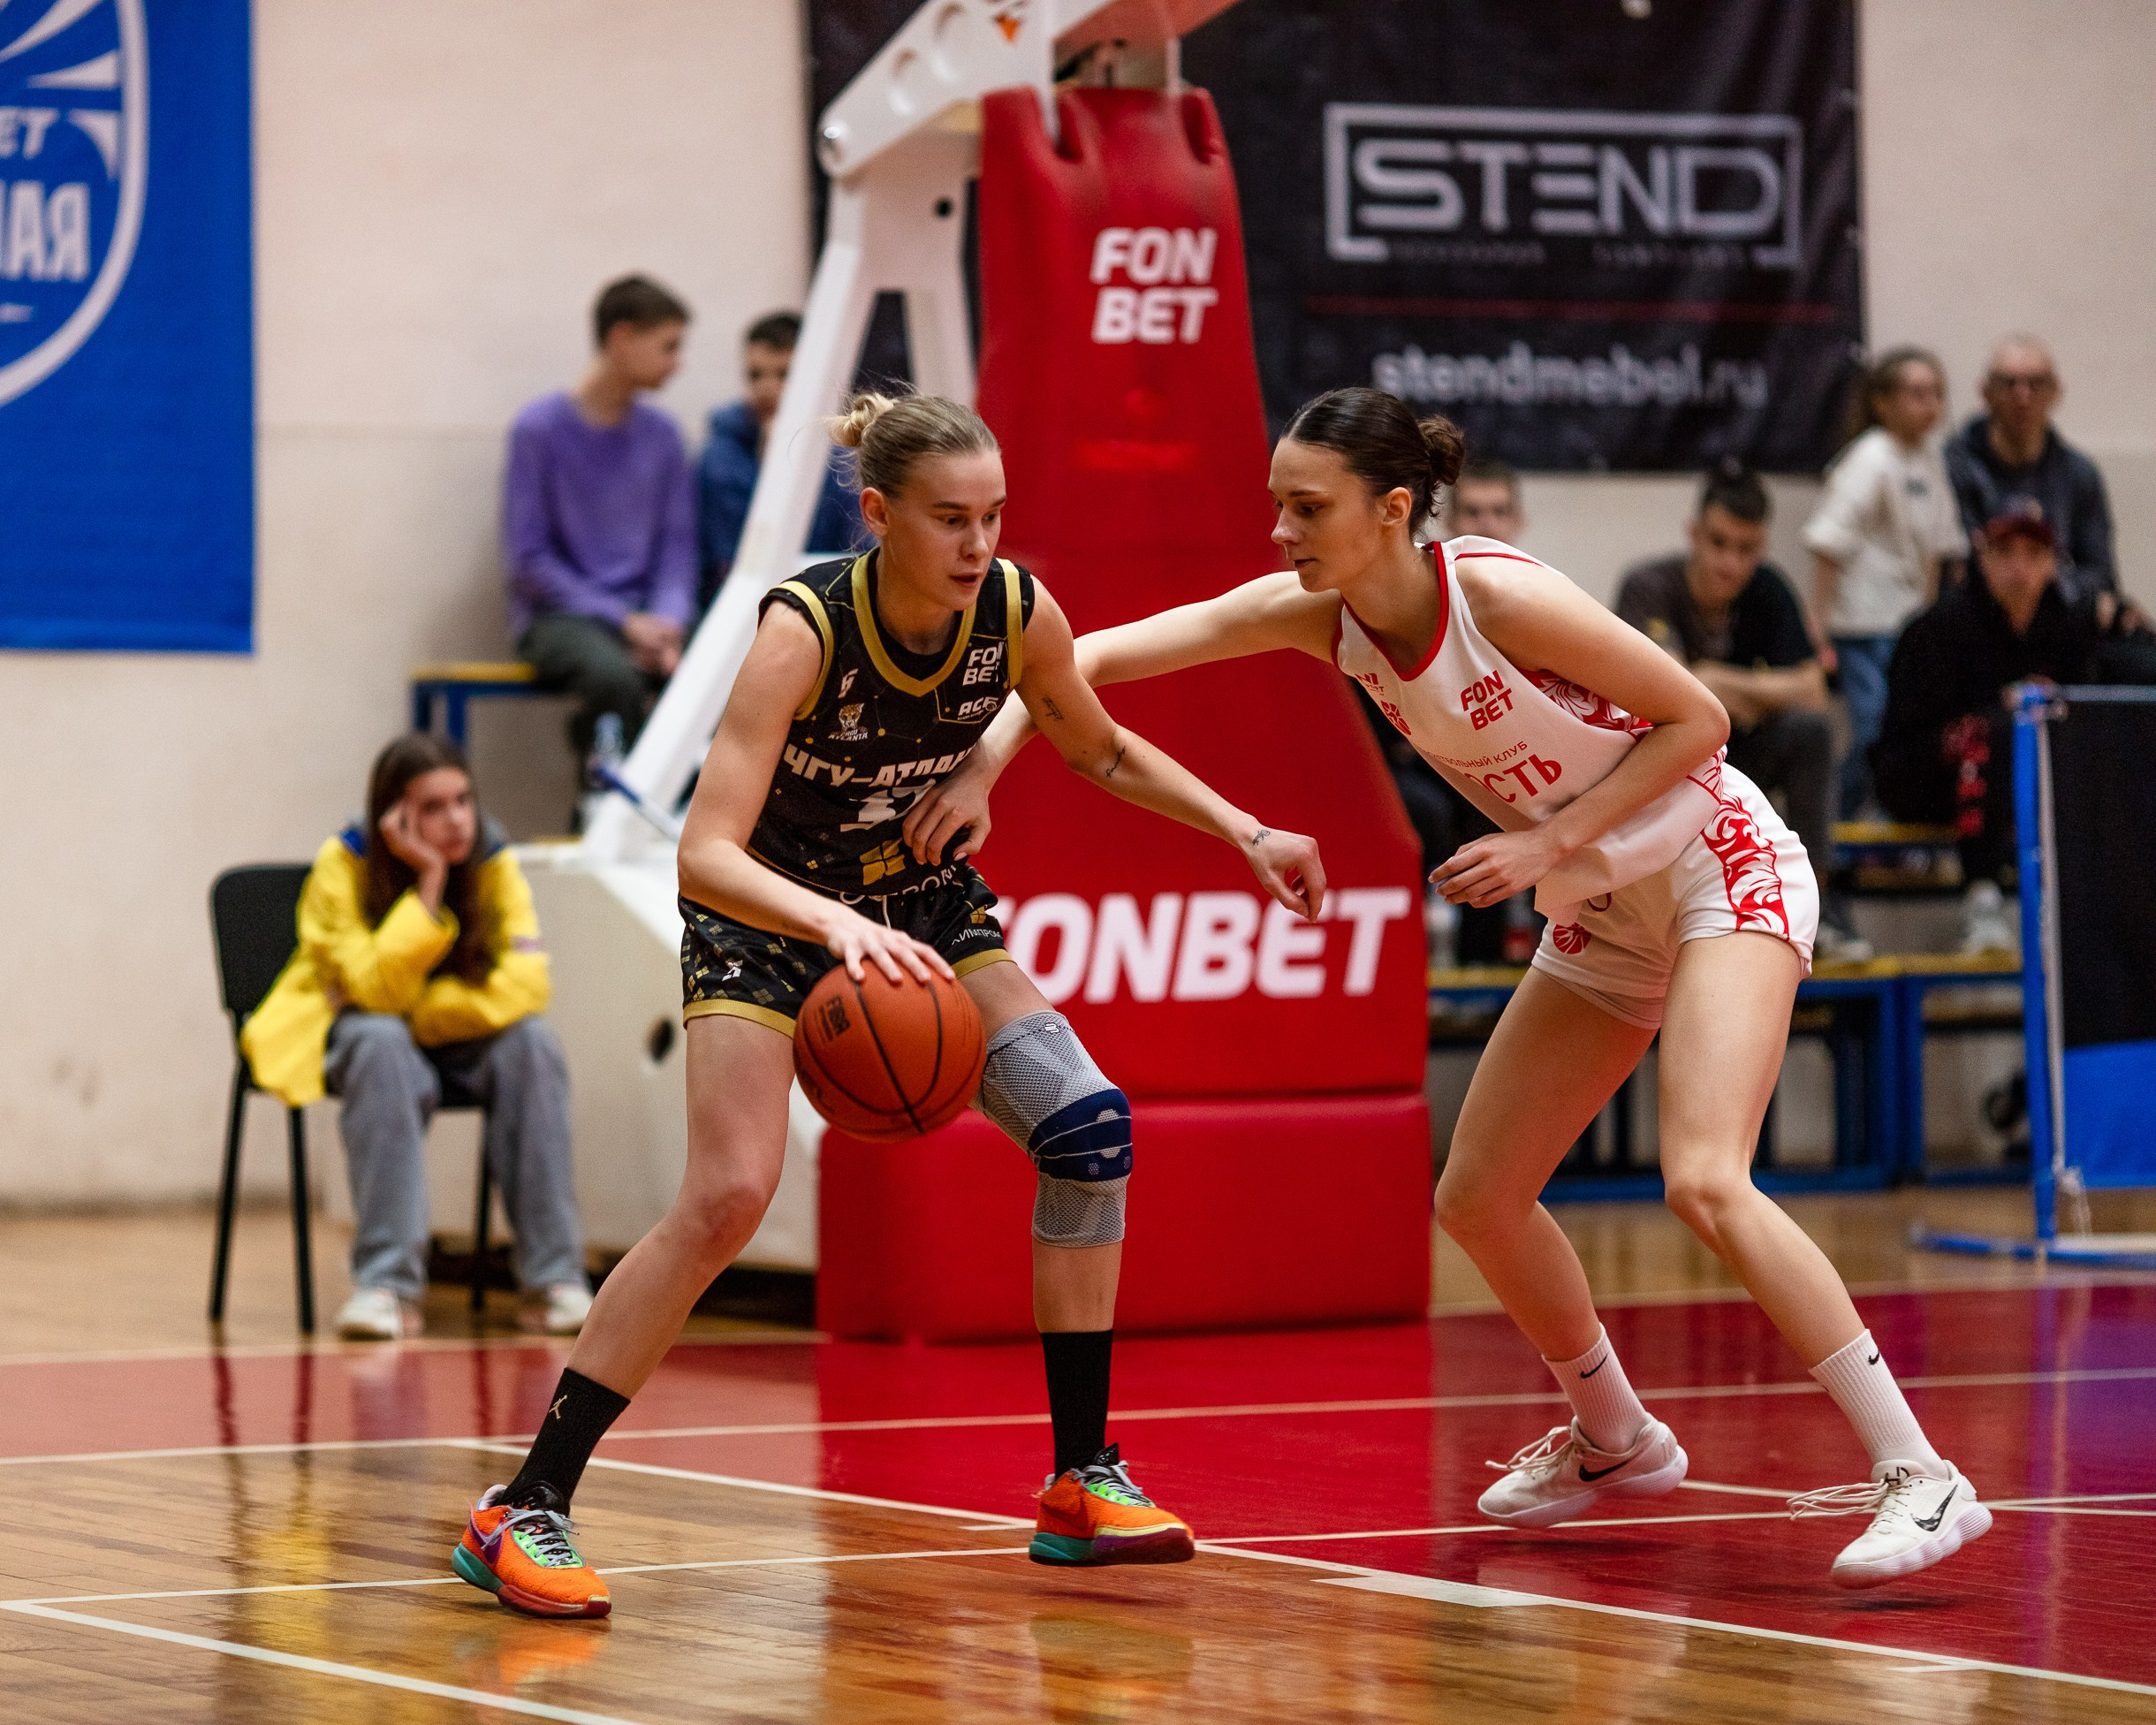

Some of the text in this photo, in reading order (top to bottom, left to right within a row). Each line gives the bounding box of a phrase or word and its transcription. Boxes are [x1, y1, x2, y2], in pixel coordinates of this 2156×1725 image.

[1354, 138, 1781, 238] STEND
[0, 179, 90, 283] АЯ
[1089, 226, 1218, 285] FON
[1091, 286, 1219, 345] BET
[1372, 339, 1768, 409] stendmebel.ru
[962, 662, 999, 687] BE
[1461, 670, 1505, 712] FON
[1470, 688, 1514, 731] BET
[1493, 741, 1528, 764] КЛУБ
